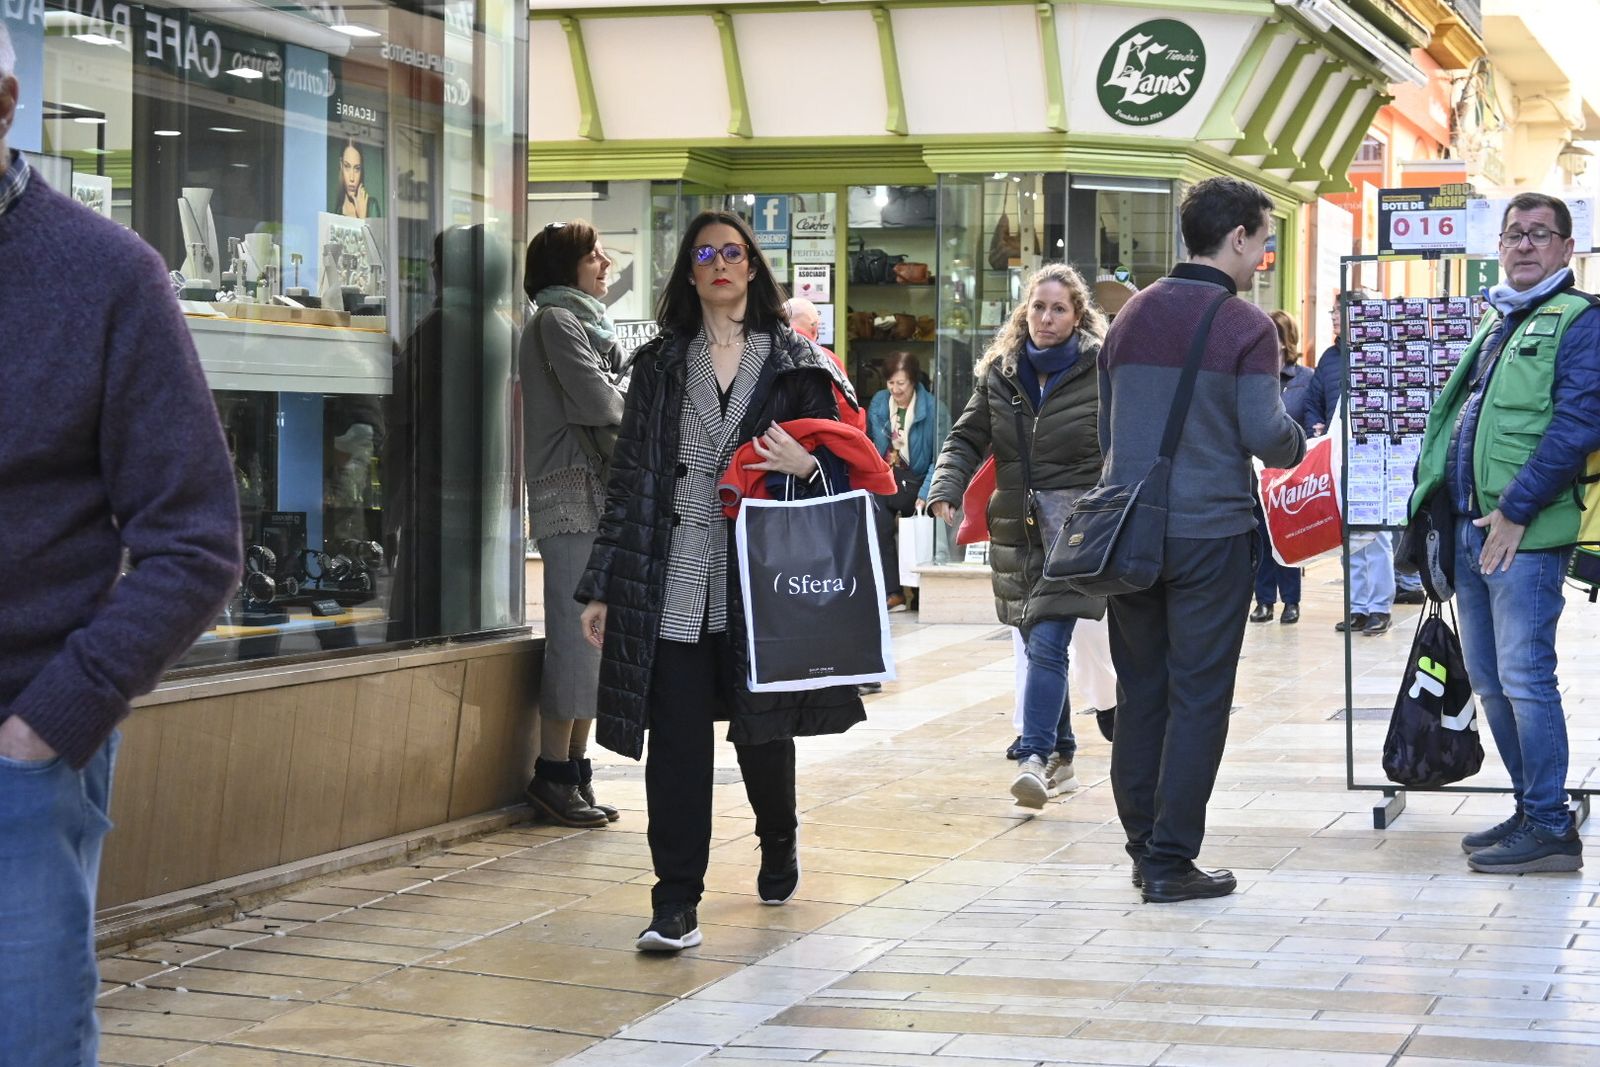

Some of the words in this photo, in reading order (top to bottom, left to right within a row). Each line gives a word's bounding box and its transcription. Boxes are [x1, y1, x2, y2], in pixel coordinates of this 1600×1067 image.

[1440, 183, 1475, 196] EURO
[1382, 203, 1409, 211] BOTE
[1410, 202, 1424, 210] DE
[788, 574, 845, 595] Sfera
